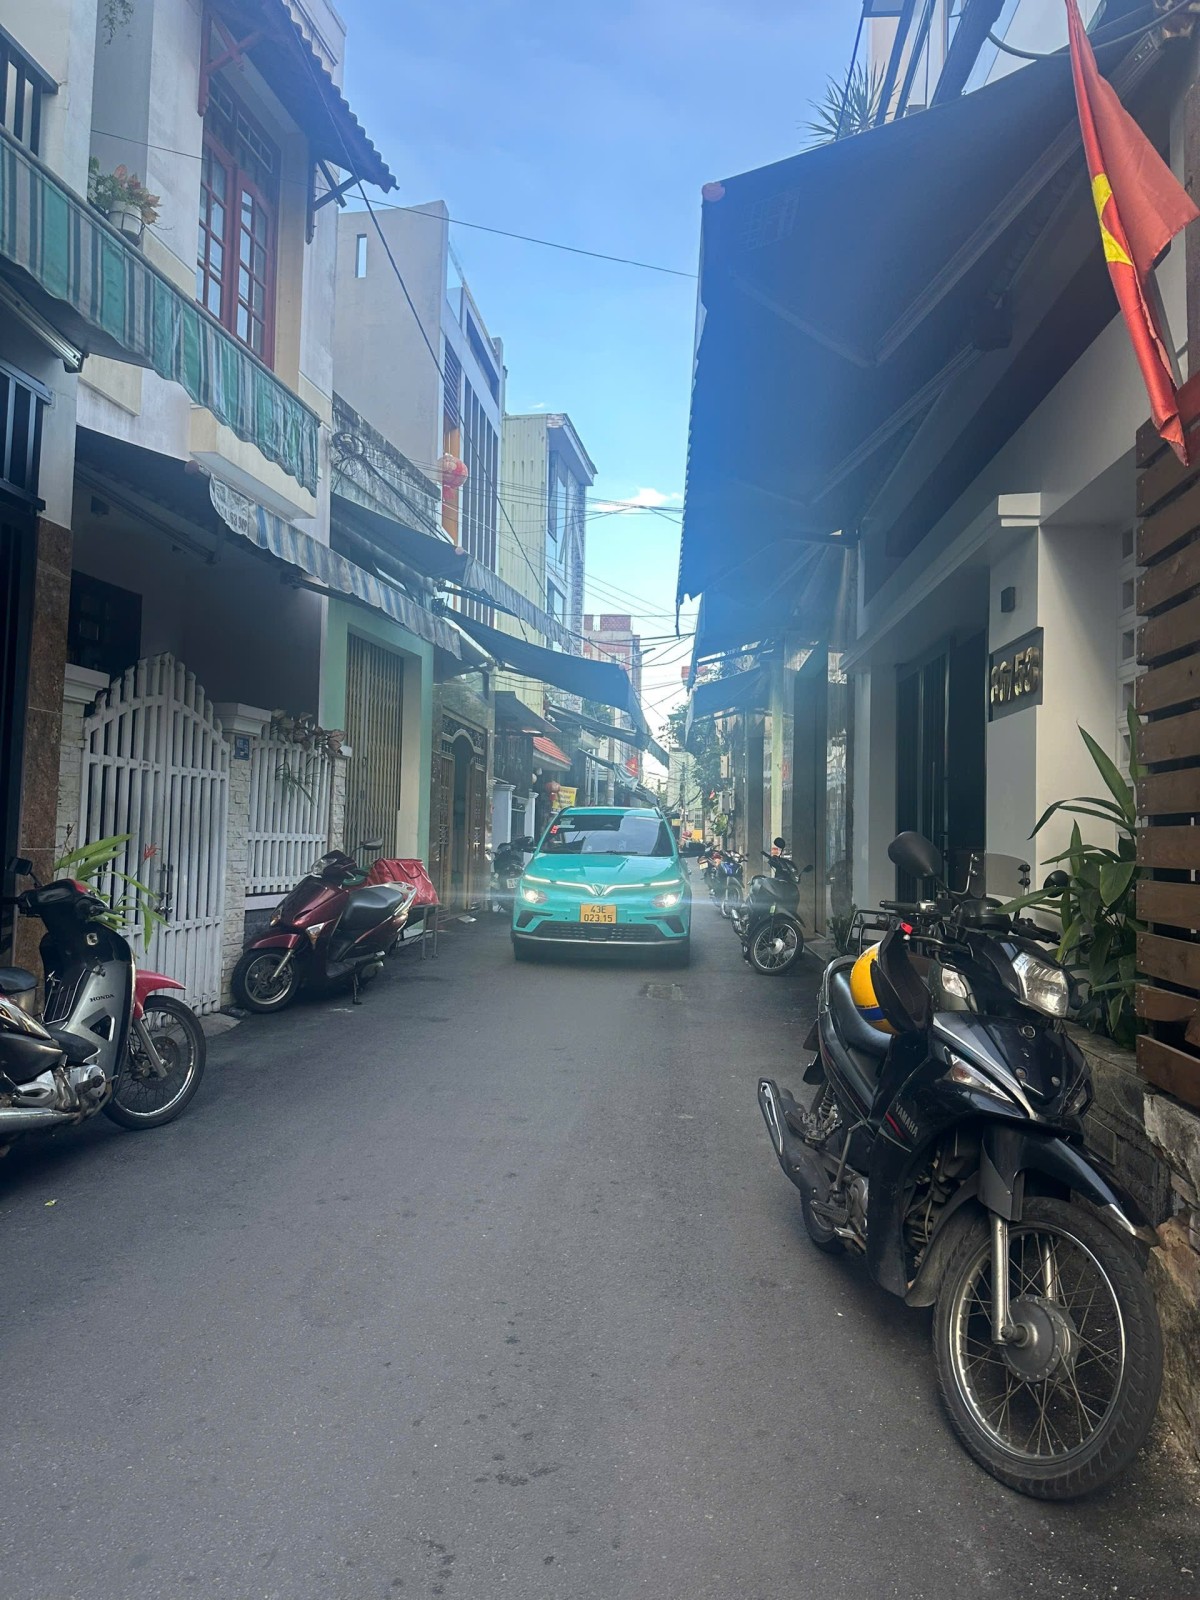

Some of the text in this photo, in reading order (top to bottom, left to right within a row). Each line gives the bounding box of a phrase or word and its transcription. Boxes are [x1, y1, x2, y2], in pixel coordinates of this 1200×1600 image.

[590, 905, 607, 915] 43E
[89, 993, 115, 1003] HONDA
[894, 1101, 919, 1138] YAMAHA
